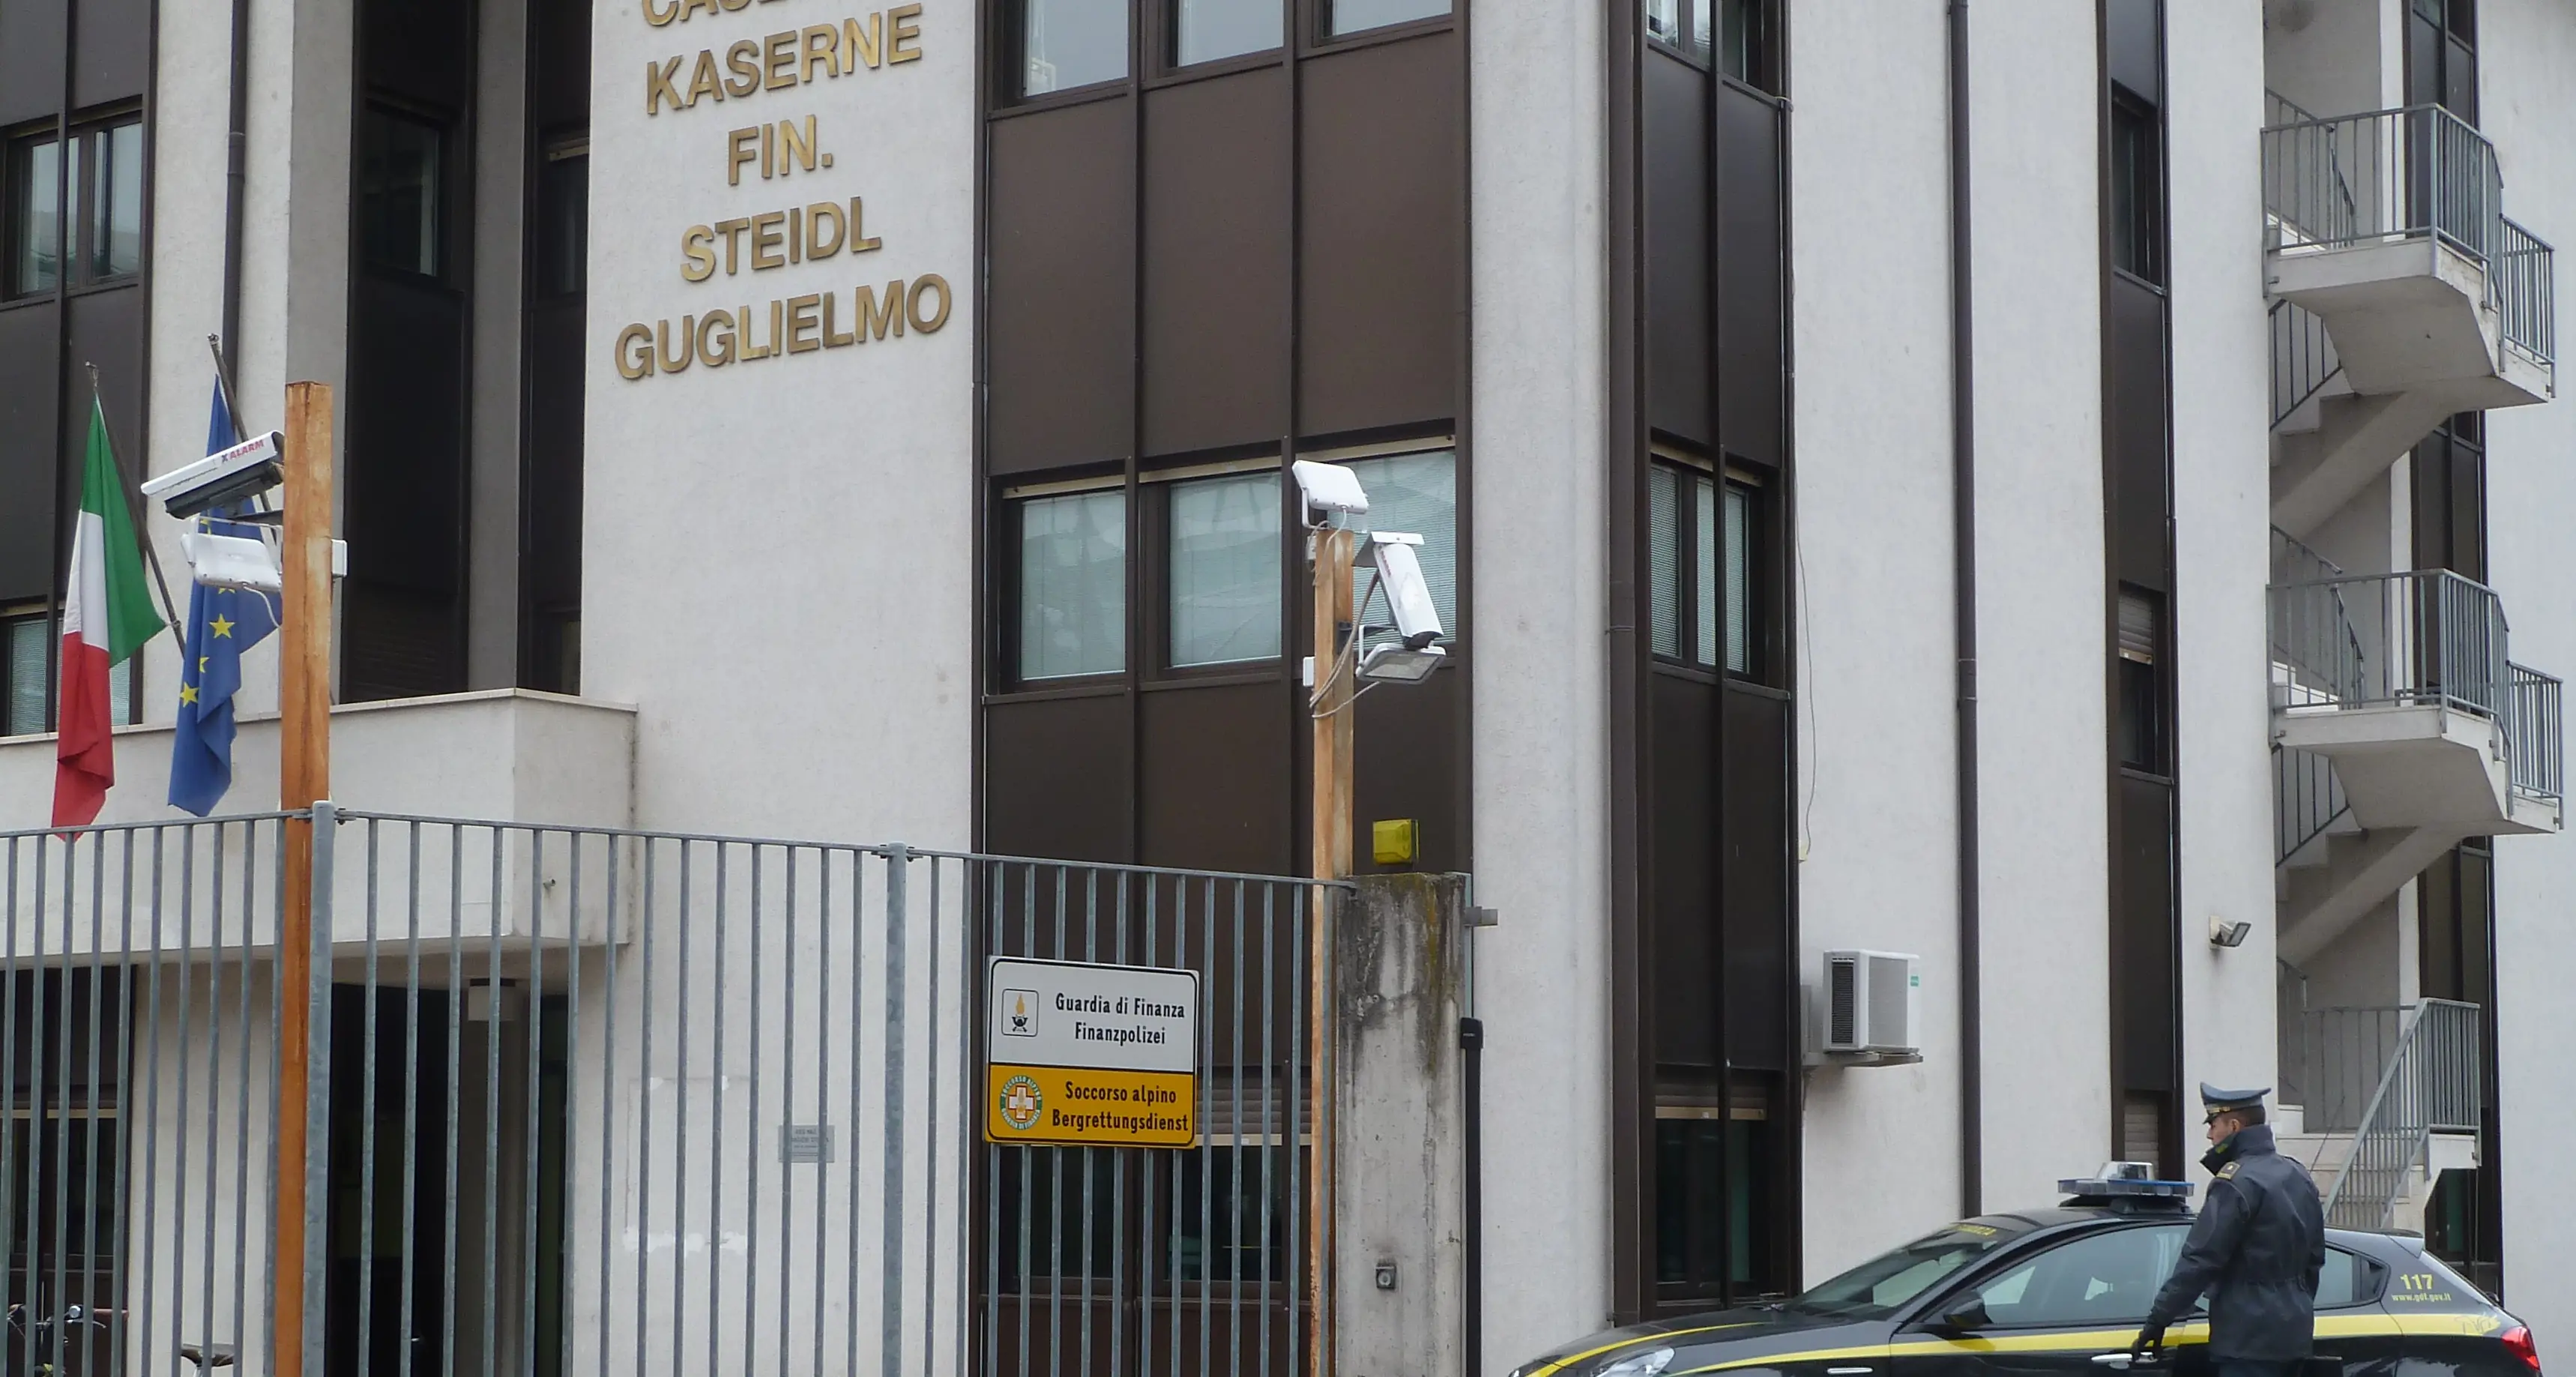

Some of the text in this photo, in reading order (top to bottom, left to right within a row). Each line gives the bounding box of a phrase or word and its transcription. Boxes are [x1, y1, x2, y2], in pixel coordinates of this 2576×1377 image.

[646, 3, 923, 115] KASERNE
[728, 114, 833, 187] FIN.
[681, 196, 882, 282] STEIDL
[615, 273, 952, 380] GUGLIELMO
[1055, 992, 1185, 1018] Guardia di Finanza
[1075, 1022, 1165, 1046] Finanzpolizei
[1065, 1080, 1177, 1106] Soccorso alpino
[1052, 1109, 1189, 1133] Bergrettungsdienst
[2400, 1274, 2433, 1290] 117
